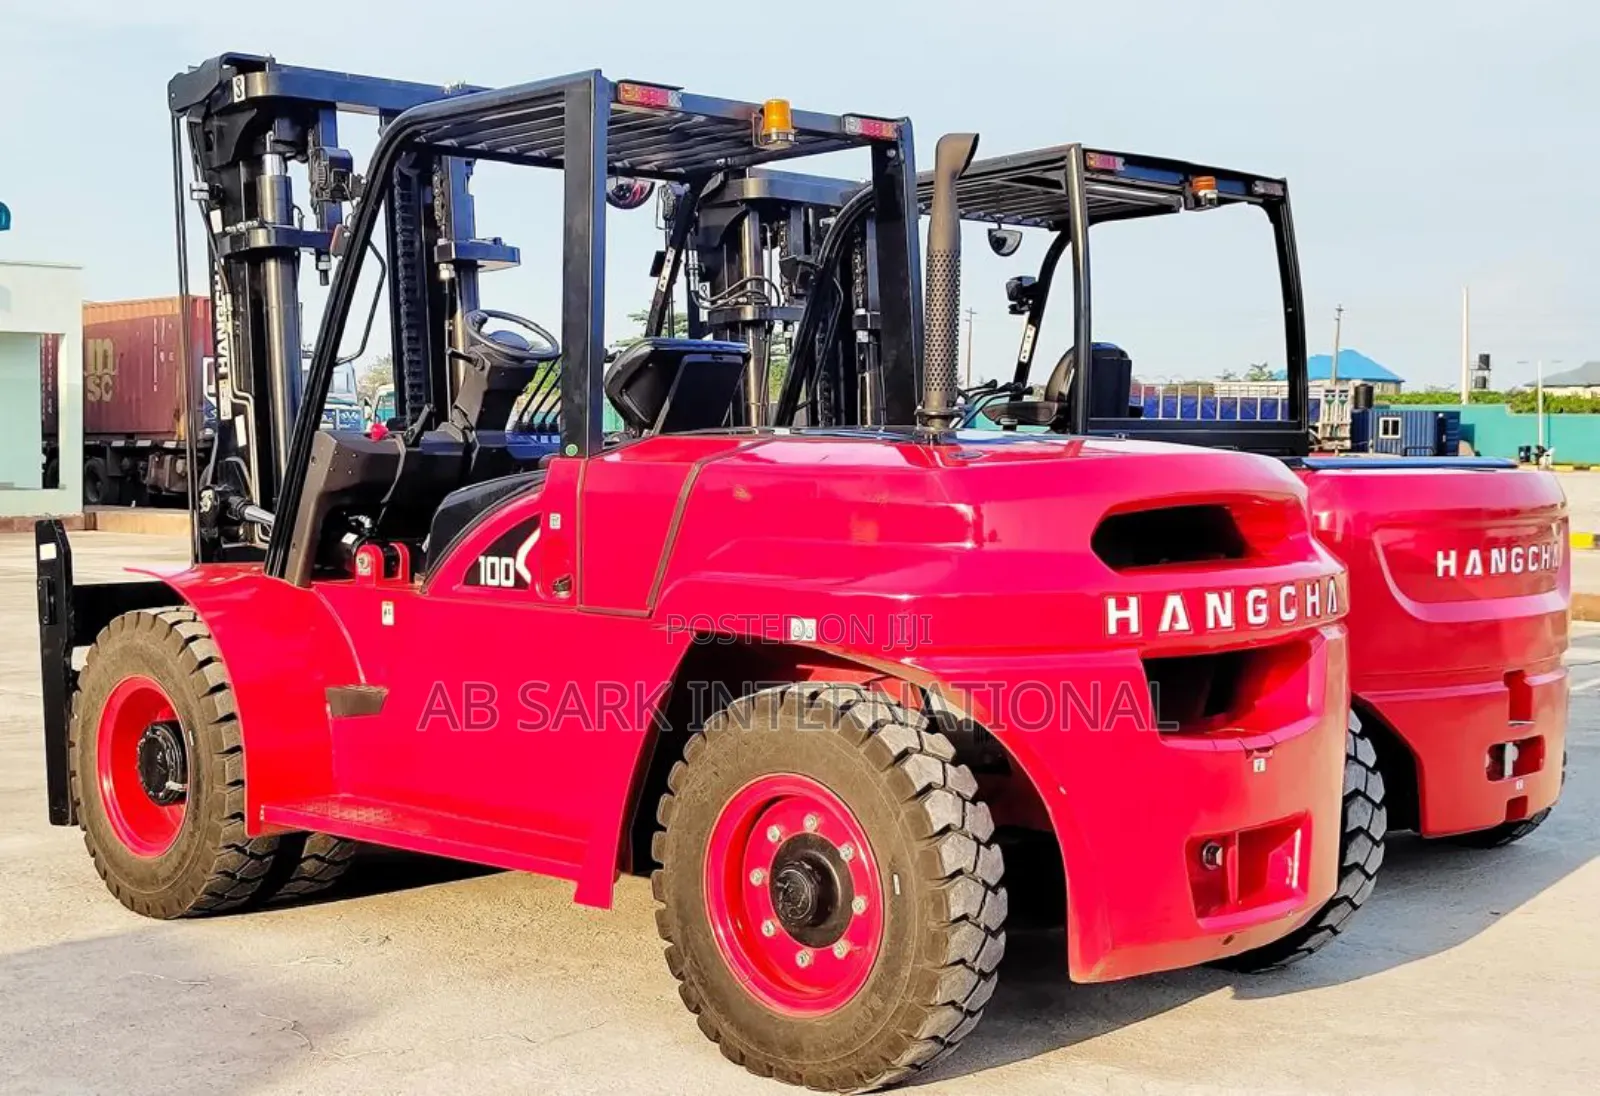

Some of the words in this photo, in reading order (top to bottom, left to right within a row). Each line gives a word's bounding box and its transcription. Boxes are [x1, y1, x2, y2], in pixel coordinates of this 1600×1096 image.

[478, 555, 515, 587] 100
[1436, 542, 1559, 577] HANGCHA
[1107, 576, 1339, 635] HANGCHA
